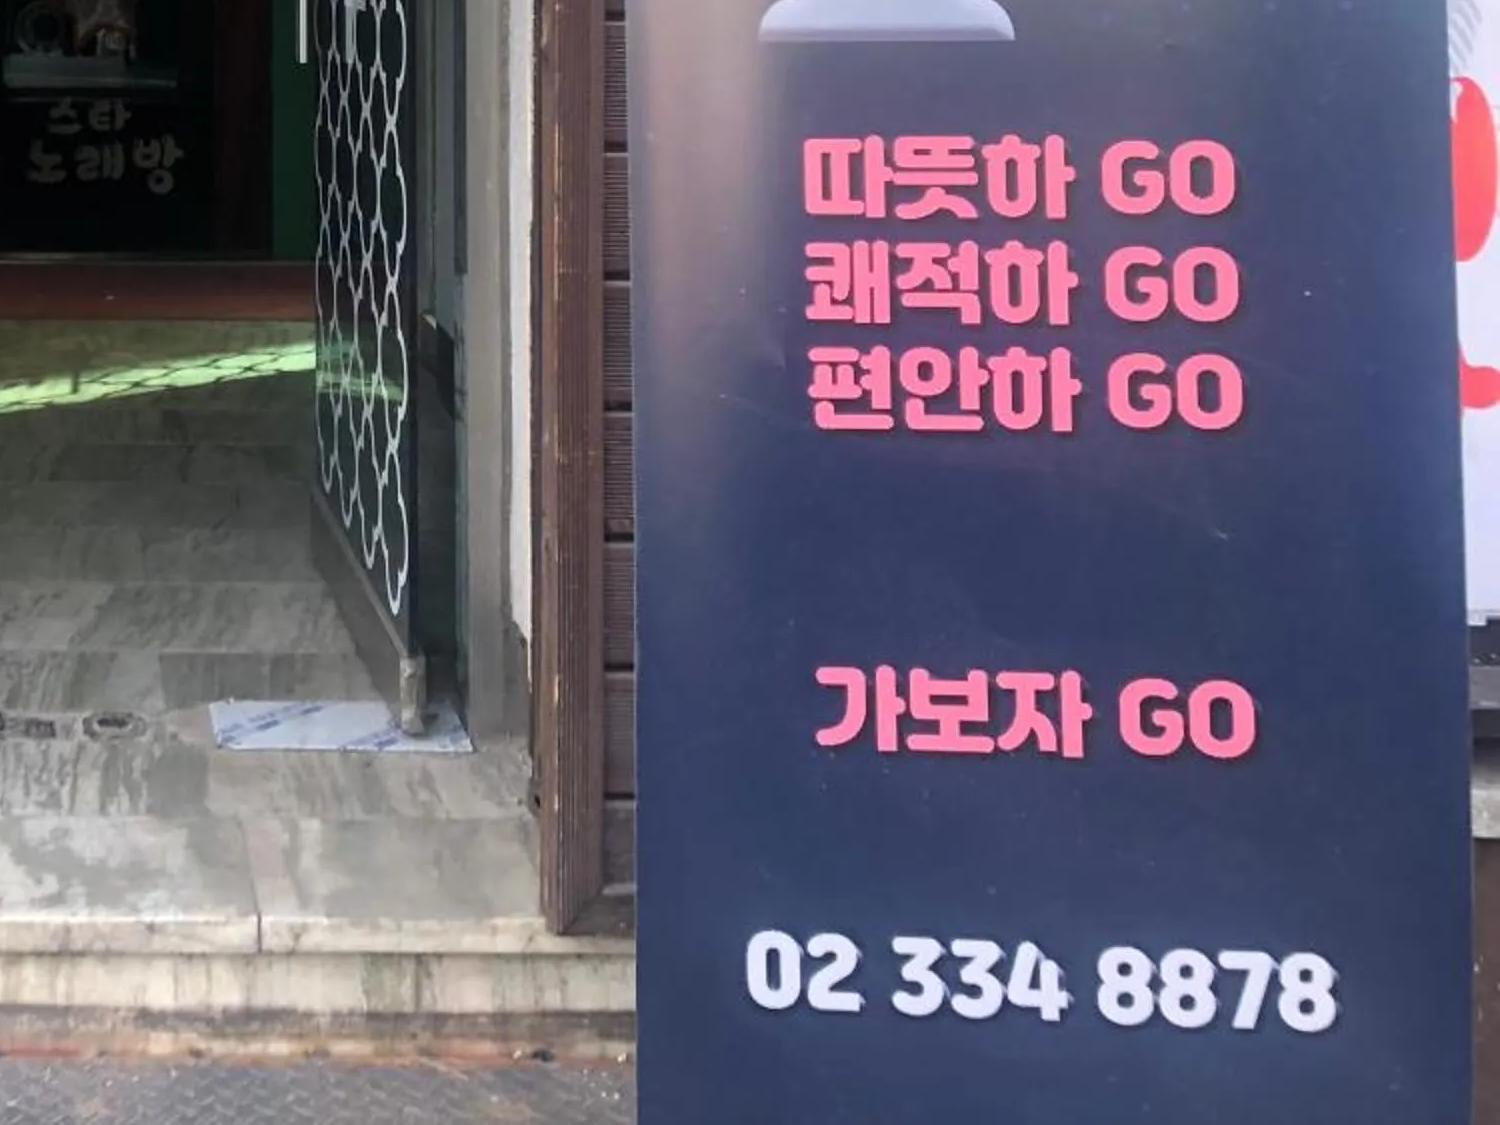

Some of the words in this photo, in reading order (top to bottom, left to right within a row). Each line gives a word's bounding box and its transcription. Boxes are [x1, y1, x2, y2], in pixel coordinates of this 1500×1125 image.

[46, 97, 133, 136] 스타
[27, 133, 185, 196] 노래방
[803, 134, 1077, 221] 따뜻하
[1101, 139, 1236, 216] GO
[804, 239, 1080, 326] 쾌적하
[1103, 245, 1240, 323] GO
[807, 345, 1083, 432] 편안하
[1106, 352, 1244, 431] GO
[814, 664, 1093, 759] 가보자
[1118, 678, 1257, 759] GO
[745, 929, 866, 1013] 02
[890, 935, 1074, 1022] 334
[1096, 945, 1341, 1033] 8878
